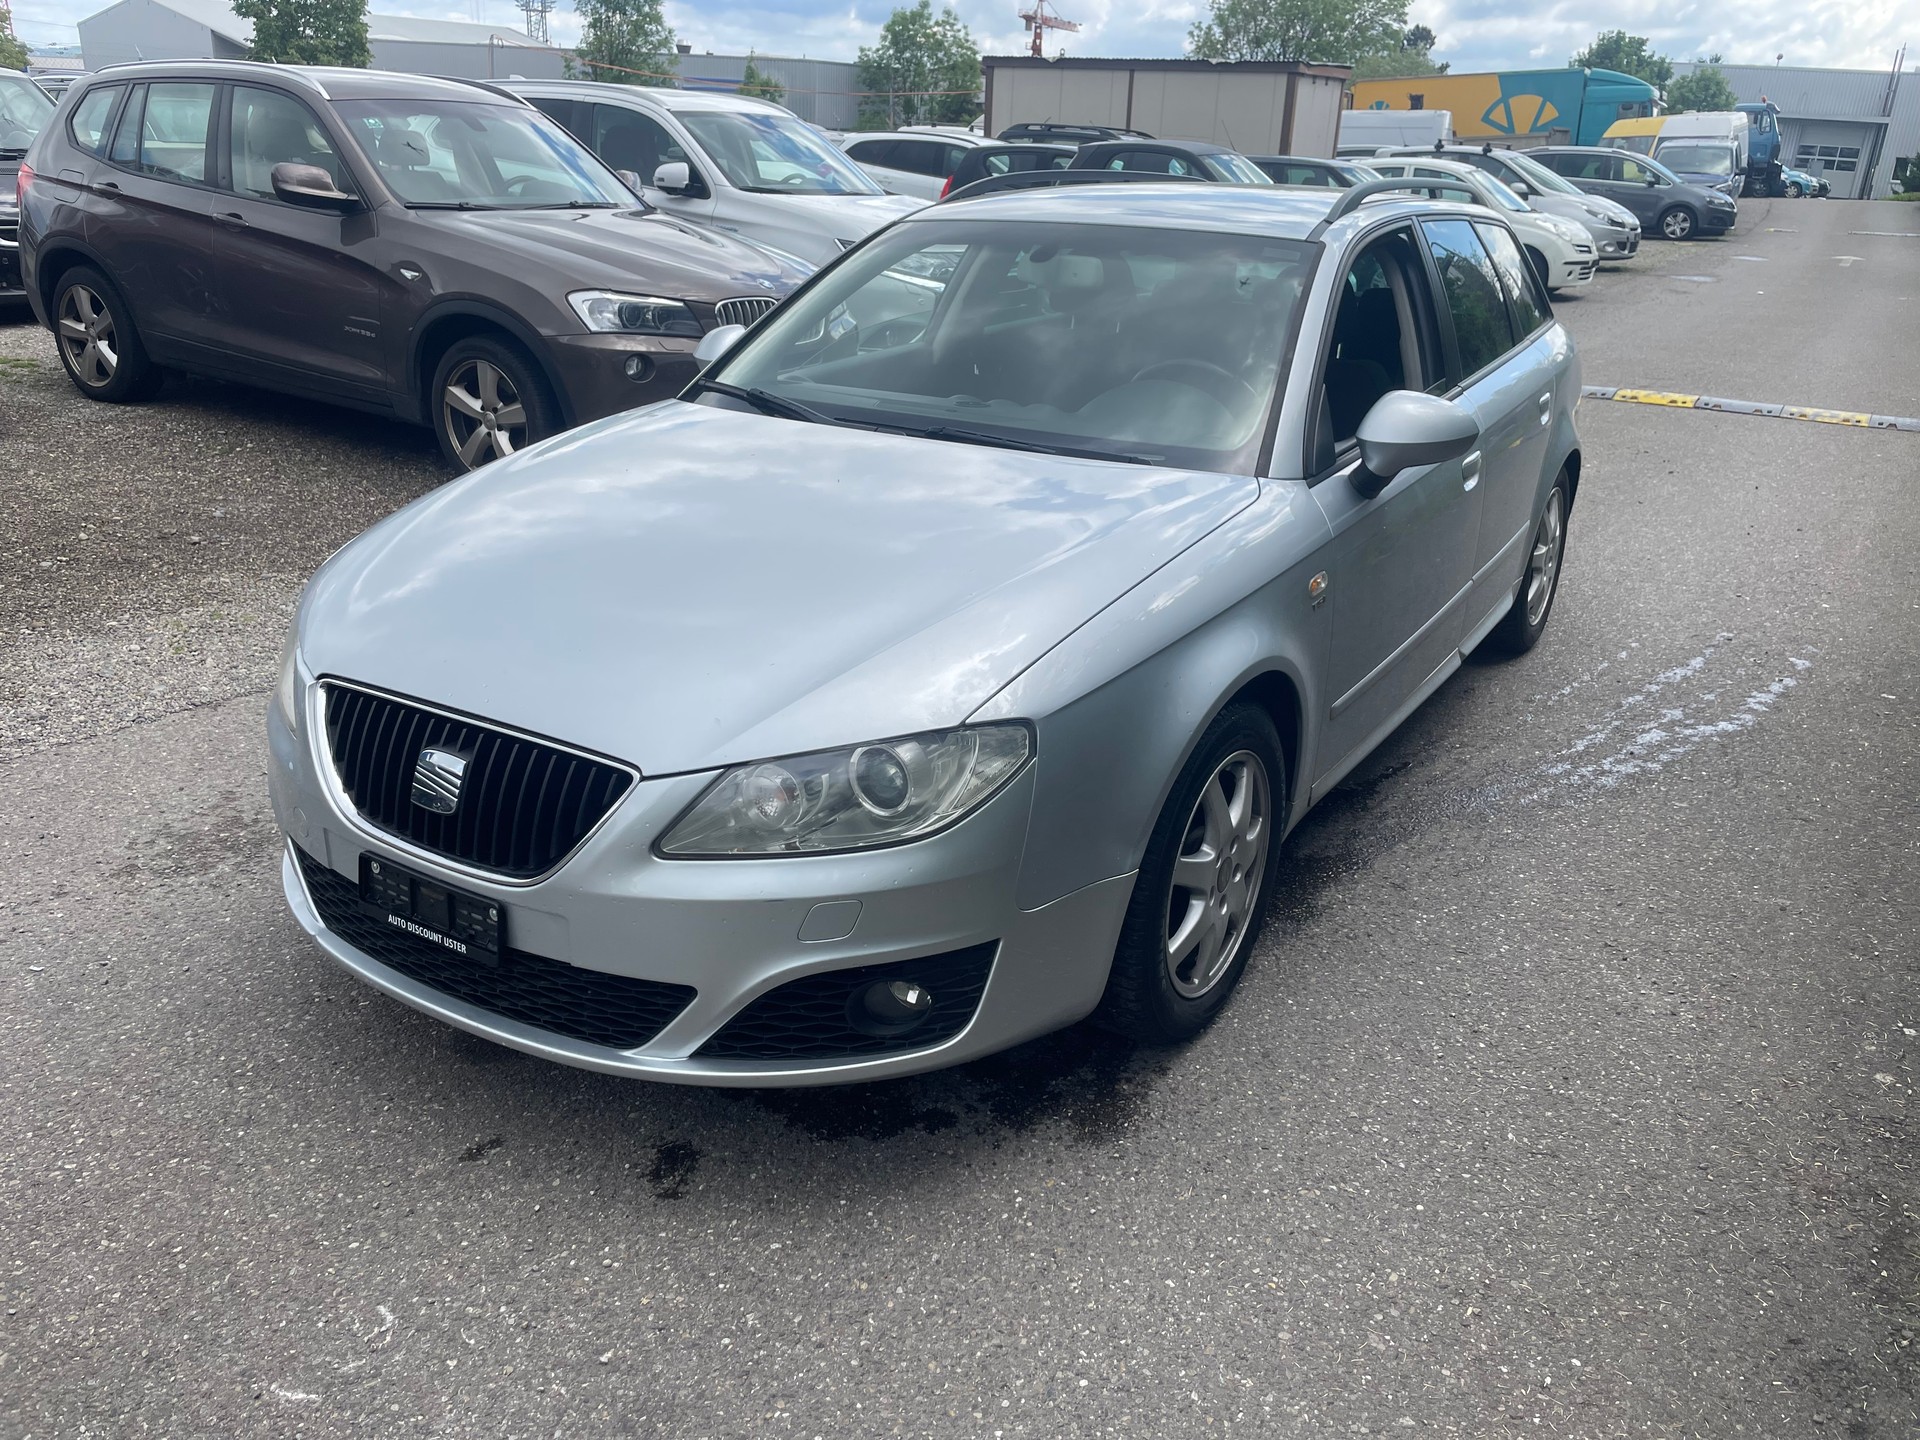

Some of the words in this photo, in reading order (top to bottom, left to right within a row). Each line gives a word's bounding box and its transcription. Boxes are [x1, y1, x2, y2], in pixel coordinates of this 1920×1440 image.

[388, 914, 406, 929] AUTO
[407, 921, 442, 944] DISCOUNT
[443, 937, 467, 954] USTER
